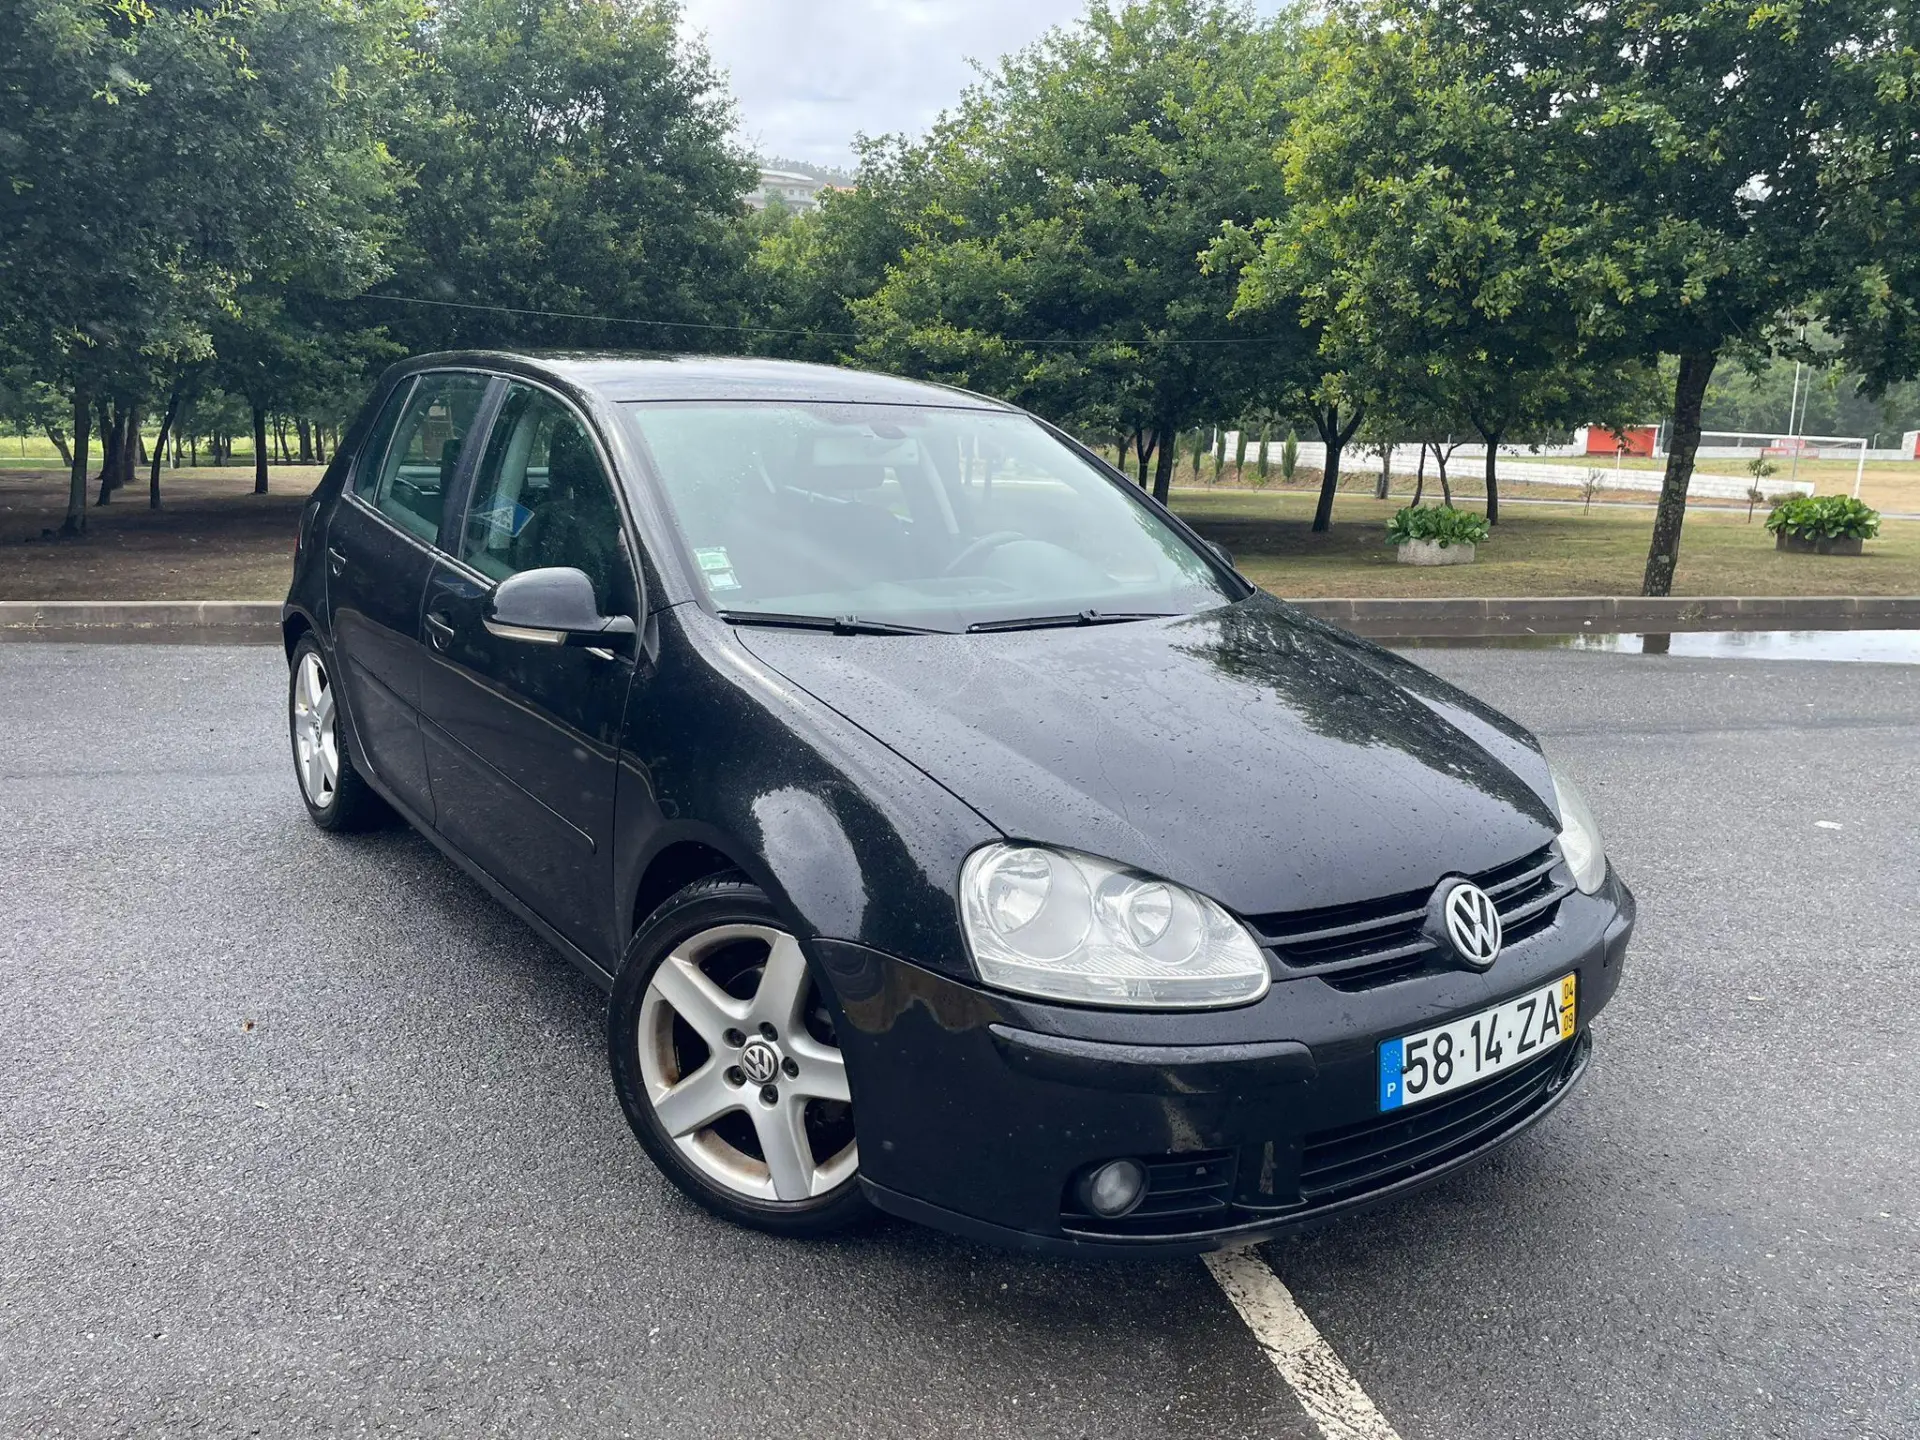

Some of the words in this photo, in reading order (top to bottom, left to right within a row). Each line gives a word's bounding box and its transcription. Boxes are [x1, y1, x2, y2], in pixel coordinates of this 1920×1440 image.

[1447, 885, 1501, 964] VW
[1564, 981, 1574, 999] 04
[1564, 1012, 1574, 1031] 09
[743, 1045, 774, 1081] VW
[1387, 1082, 1397, 1098] P
